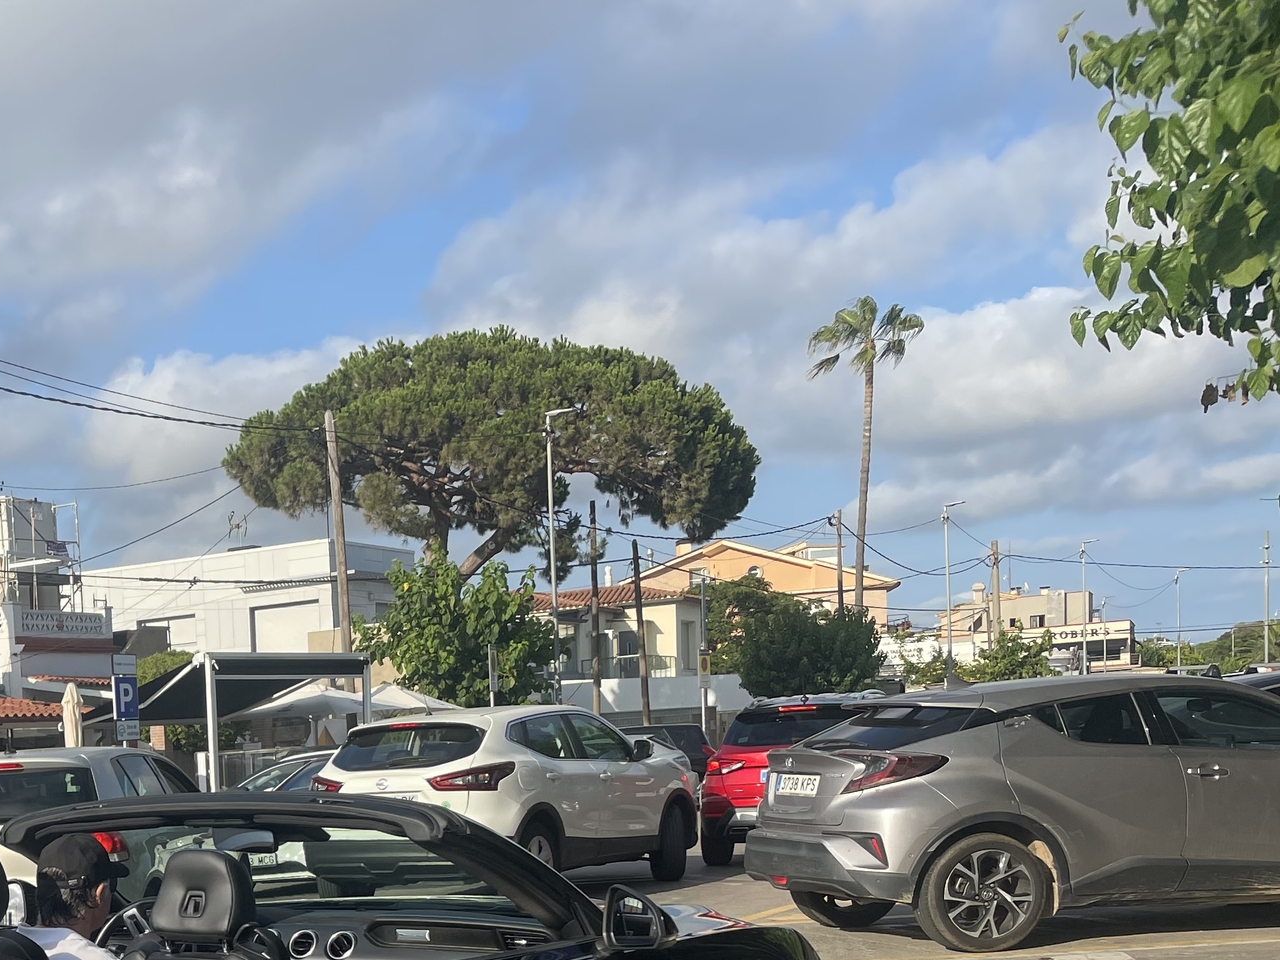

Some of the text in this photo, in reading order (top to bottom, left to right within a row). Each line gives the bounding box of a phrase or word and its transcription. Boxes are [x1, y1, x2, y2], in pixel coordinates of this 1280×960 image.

[119, 683, 133, 712] P
[781, 777, 816, 792] 3738 KPS
[257, 855, 274, 865] MCG
